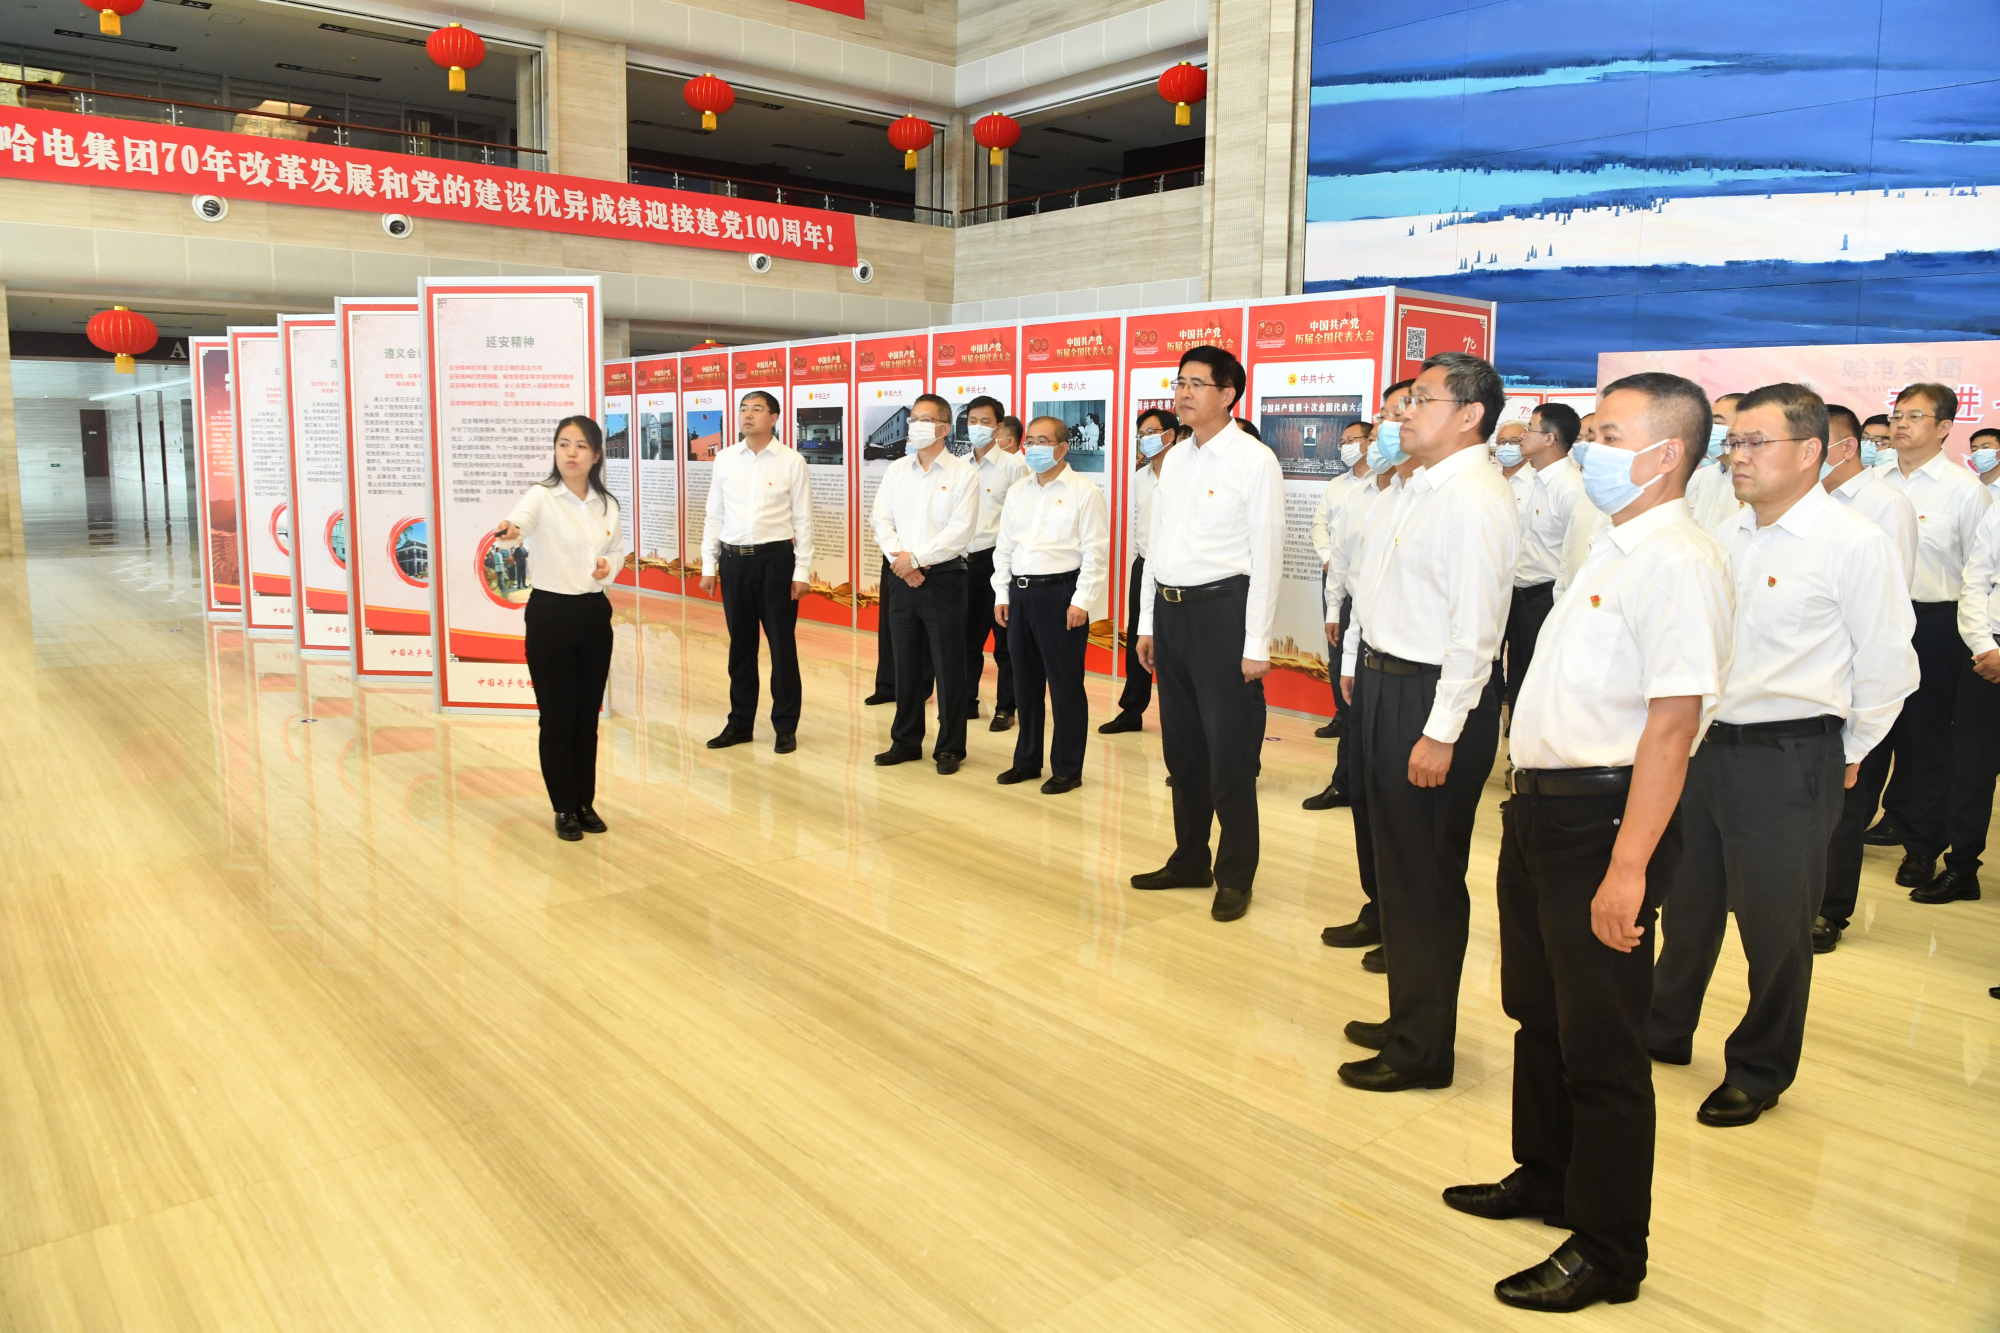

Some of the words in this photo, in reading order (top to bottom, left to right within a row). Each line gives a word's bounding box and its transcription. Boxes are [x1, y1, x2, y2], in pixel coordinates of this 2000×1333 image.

[0, 123, 834, 252] 哈电集团70年改革发展和党的建设优异成绩迎接建党100周年!
[1309, 317, 1360, 332] 中国共产党
[1179, 327, 1222, 340] 中国共产党
[1295, 329, 1375, 345] 历届全国代表大会
[485, 335, 535, 348] 延安精神
[1066, 335, 1103, 347] 中国共产党
[1166, 338, 1234, 352] 历届全国代表大会
[170, 341, 188, 358] A
[887, 349, 916, 359] 中国共产党
[970, 343, 1002, 353] 中国共产党
[1056, 345, 1113, 358] 历届全国代表大会
[961, 352, 1011, 364] 历届全国代表大会
[1300, 373, 1335, 385] 中共十大
[965, 385, 988, 394] 中共七大
[1061, 381, 1087, 391] 中共八大
[1261, 400, 1363, 414] 中国共产党第十次全国代表大会
